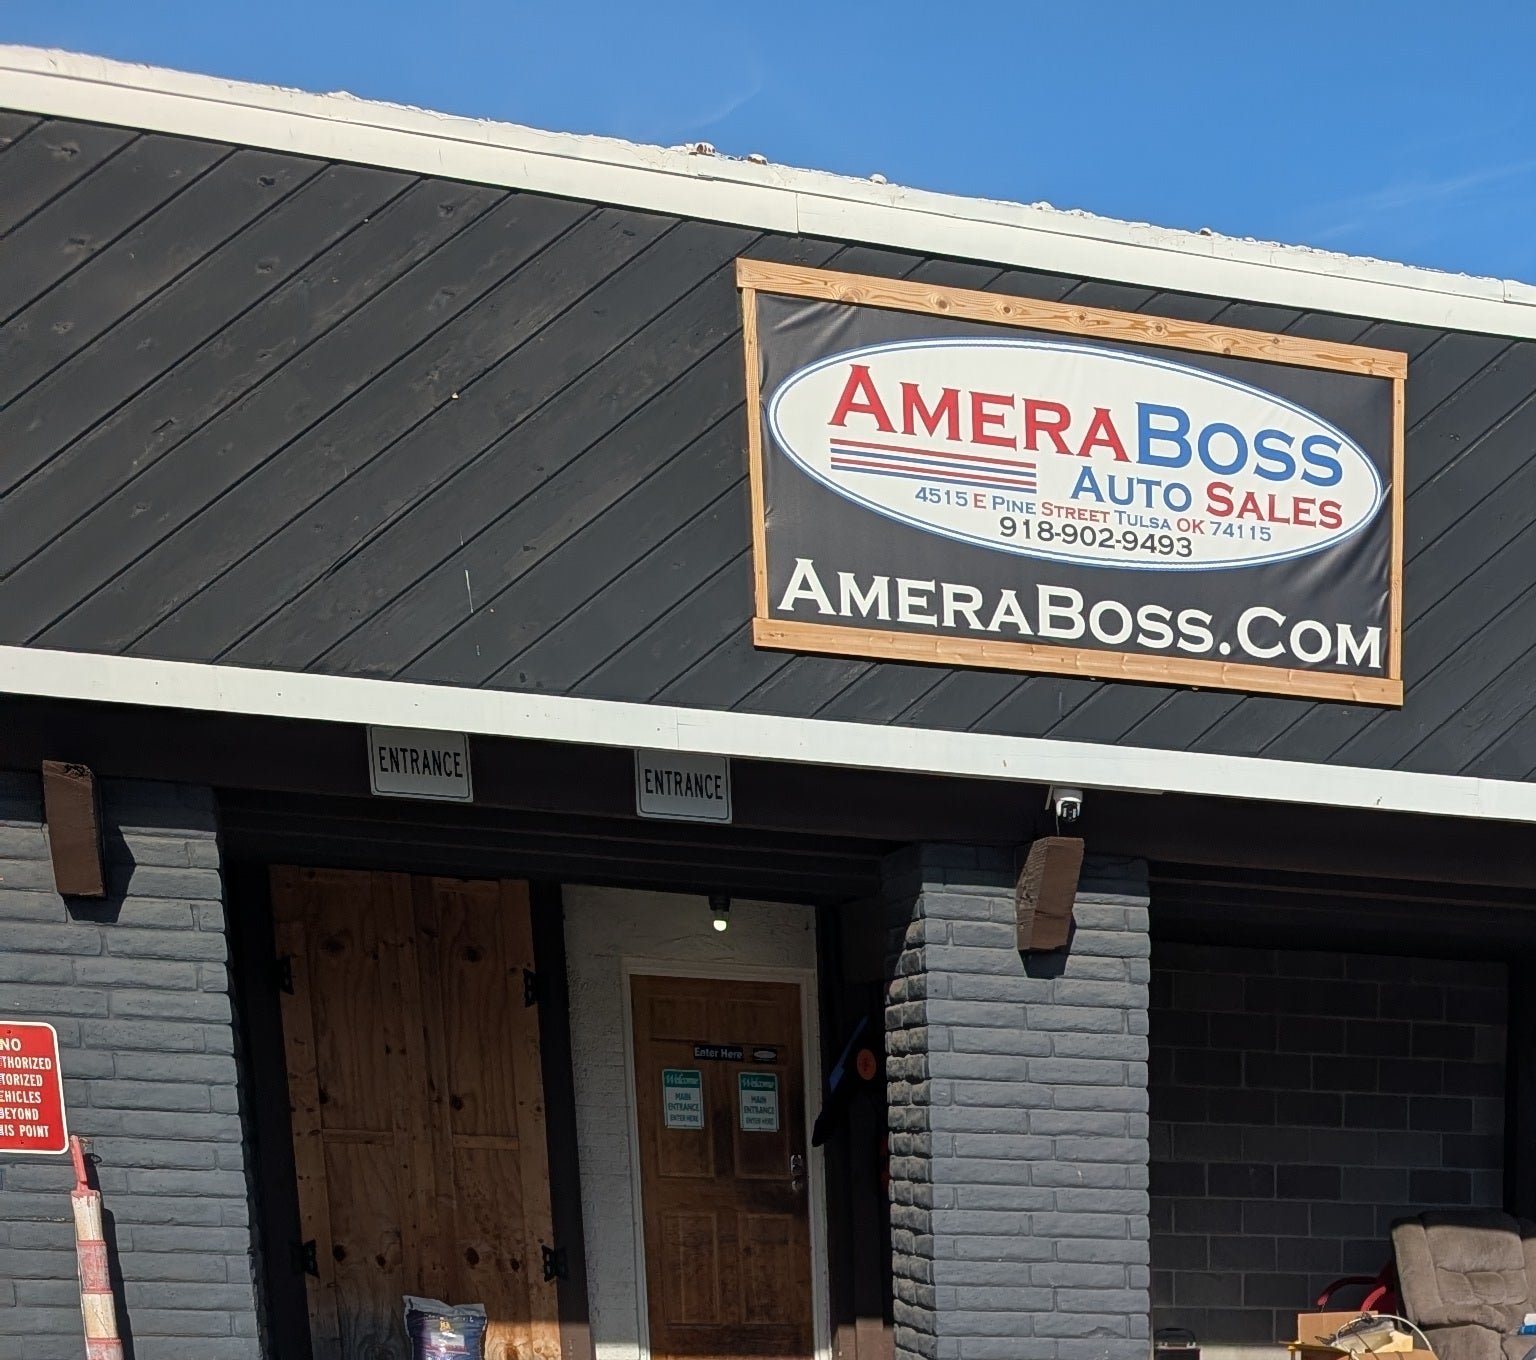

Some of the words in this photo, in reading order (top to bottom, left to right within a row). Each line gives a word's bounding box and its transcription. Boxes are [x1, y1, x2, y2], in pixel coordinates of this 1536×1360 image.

[827, 364, 1343, 487] AMERABOSS
[1070, 465, 1193, 513] AUTO
[1205, 481, 1343, 530] SALES
[914, 486, 969, 507] 4515
[973, 492, 987, 510] E
[992, 495, 1037, 516] PINE
[1041, 501, 1111, 524] STREET
[1114, 509, 1172, 532] TULSA
[1176, 517, 1206, 535] OK
[1209, 520, 1273, 542] 74115
[998, 515, 1193, 559] 918-902-9493
[777, 557, 1384, 670] AMERABOSS.COM
[378, 746, 464, 779] ENTRANCE
[644, 768, 723, 801] ENTRANCE
[0, 1037, 22, 1052] NO
[694, 1046, 718, 1059] Enter
[720, 1048, 743, 1060] Here
[667, 1102, 700, 1112] ENTRANCE
[674, 1092, 692, 1101] MAIN
[750, 1095, 767, 1104] MAIN
[743, 1105, 775, 1115] ENTRANCE
[19, 1124, 49, 1138] POINT
